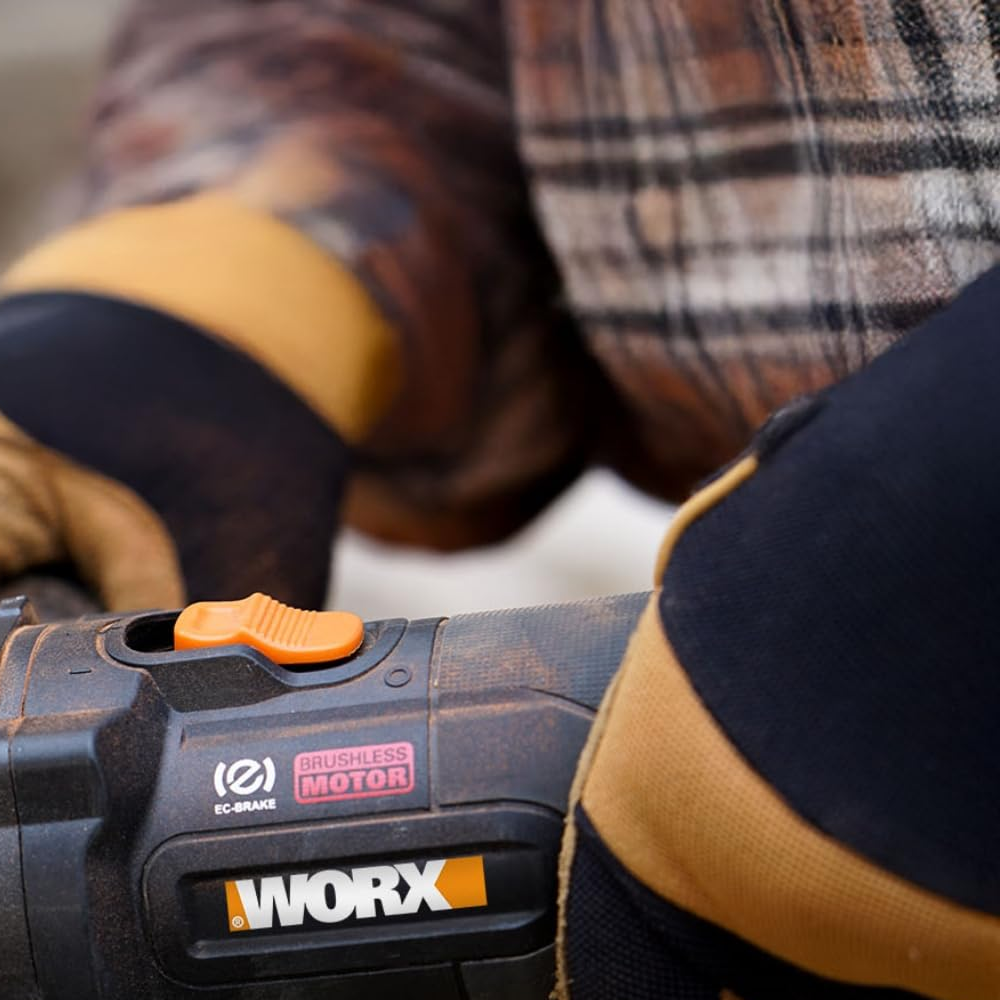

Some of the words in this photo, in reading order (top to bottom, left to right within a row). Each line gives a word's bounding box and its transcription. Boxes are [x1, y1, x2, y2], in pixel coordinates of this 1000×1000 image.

[299, 746, 409, 772] BRUSHLESS
[300, 767, 409, 797] MOTOR
[214, 798, 277, 815] EC-BRAKE
[236, 859, 453, 930] WORX
